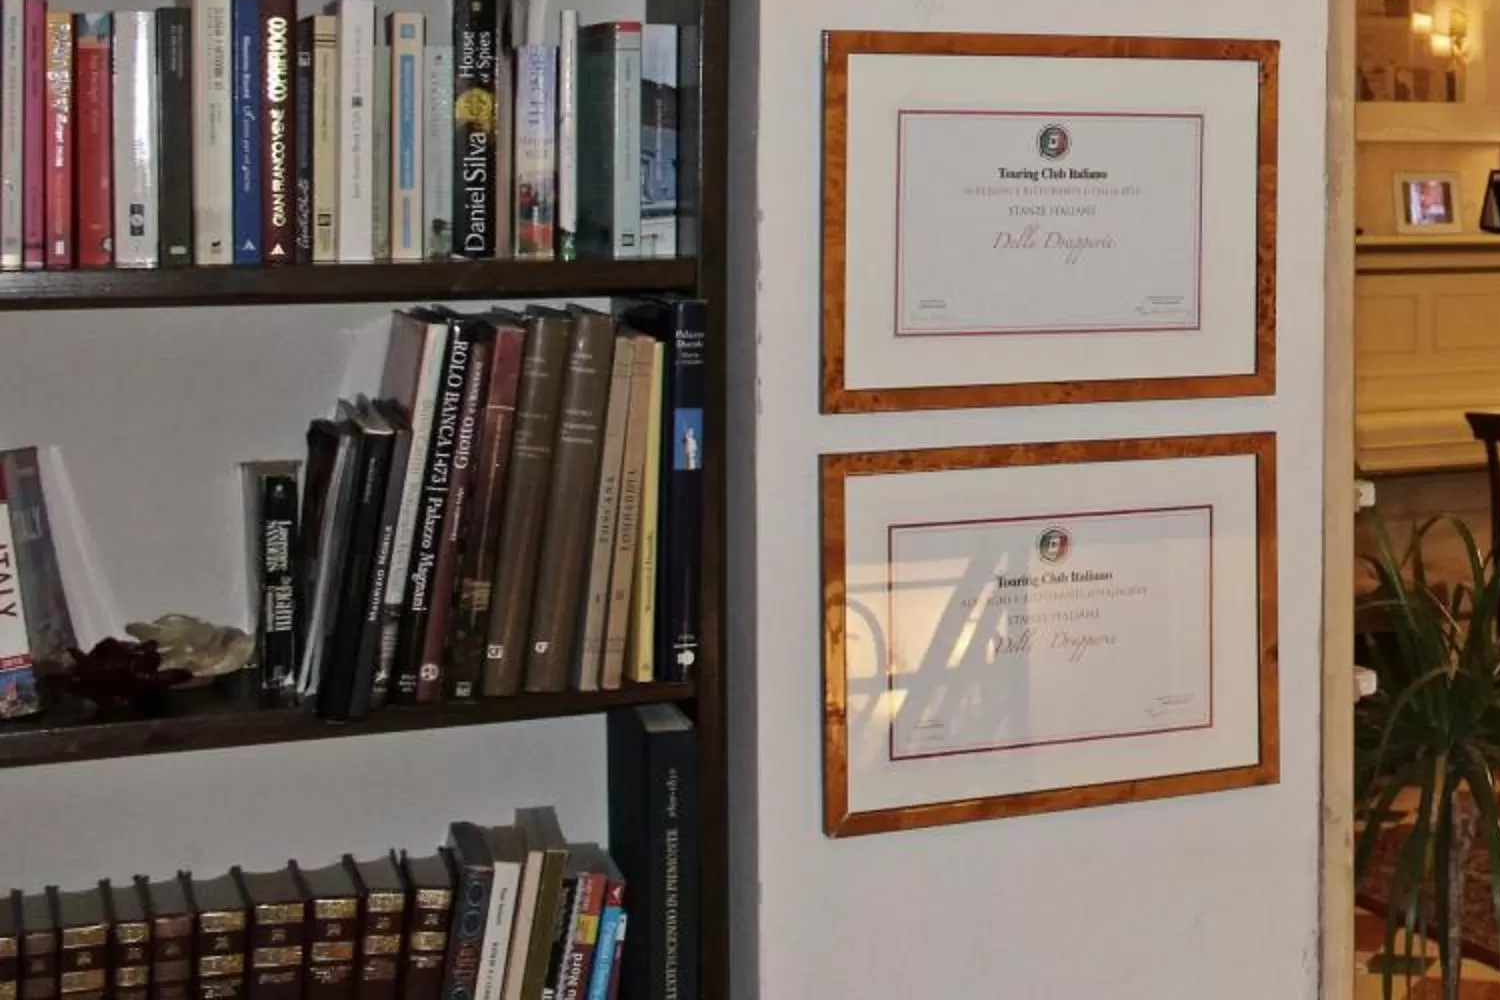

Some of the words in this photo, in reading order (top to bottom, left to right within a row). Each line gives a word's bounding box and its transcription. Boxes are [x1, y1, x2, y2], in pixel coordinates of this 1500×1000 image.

[458, 31, 476, 79] House
[475, 31, 492, 66] Spies
[463, 131, 488, 184] Silva
[998, 168, 1039, 181] Touring
[1041, 168, 1066, 180] Club
[1069, 168, 1108, 180] Italiano
[464, 187, 487, 253] Daniel
[448, 340, 469, 388] ROLO
[437, 388, 461, 450] BANCA
[421, 496, 443, 549] Palazzo
[411, 553, 435, 611] Magnani
[996, 575, 1038, 588] Touring
[1041, 571, 1068, 583] Club
[1071, 569, 1113, 582] Italiano
[568, 952, 583, 986] Nord
